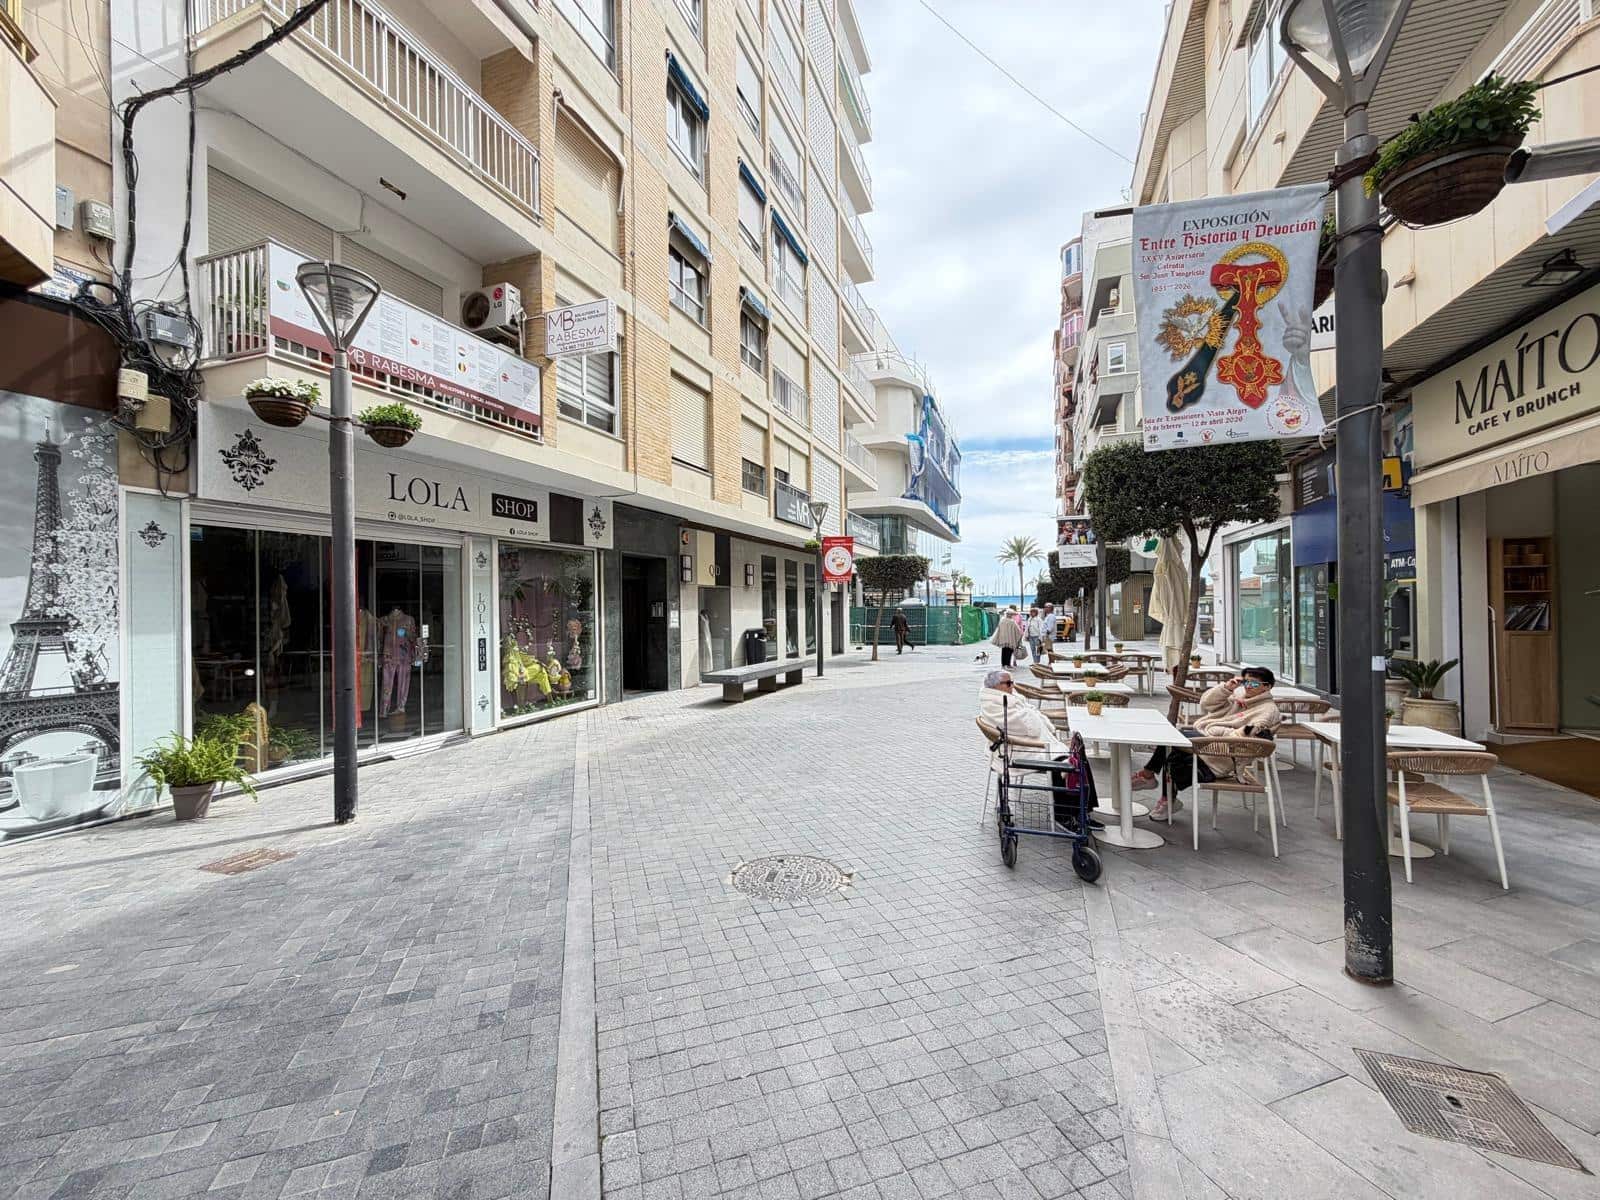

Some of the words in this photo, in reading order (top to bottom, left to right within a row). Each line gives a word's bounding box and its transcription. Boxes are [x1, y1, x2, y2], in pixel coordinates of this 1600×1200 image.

[1140, 237, 1176, 251] Entre
[1182, 231, 1237, 249] Historia
[1241, 232, 1249, 242] y
[1255, 219, 1317, 238] Devoción
[1183, 209, 1271, 232] EXPOSICIÓN
[548, 310, 575, 332] MB
[548, 325, 606, 345] RABESMA
[346, 348, 366, 365] MB
[371, 355, 436, 388] RABESMA
[1455, 313, 1600, 424] MAÍTO
[1468, 414, 1499, 436] CAFE
[1502, 410, 1511, 422] Y
[1517, 382, 1581, 418] BRUNCH
[1493, 451, 1549, 484] MAÍTO
[388, 472, 471, 512] LOLA
[496, 499, 535, 518] SHOP
[477, 592, 486, 634] LOLA
